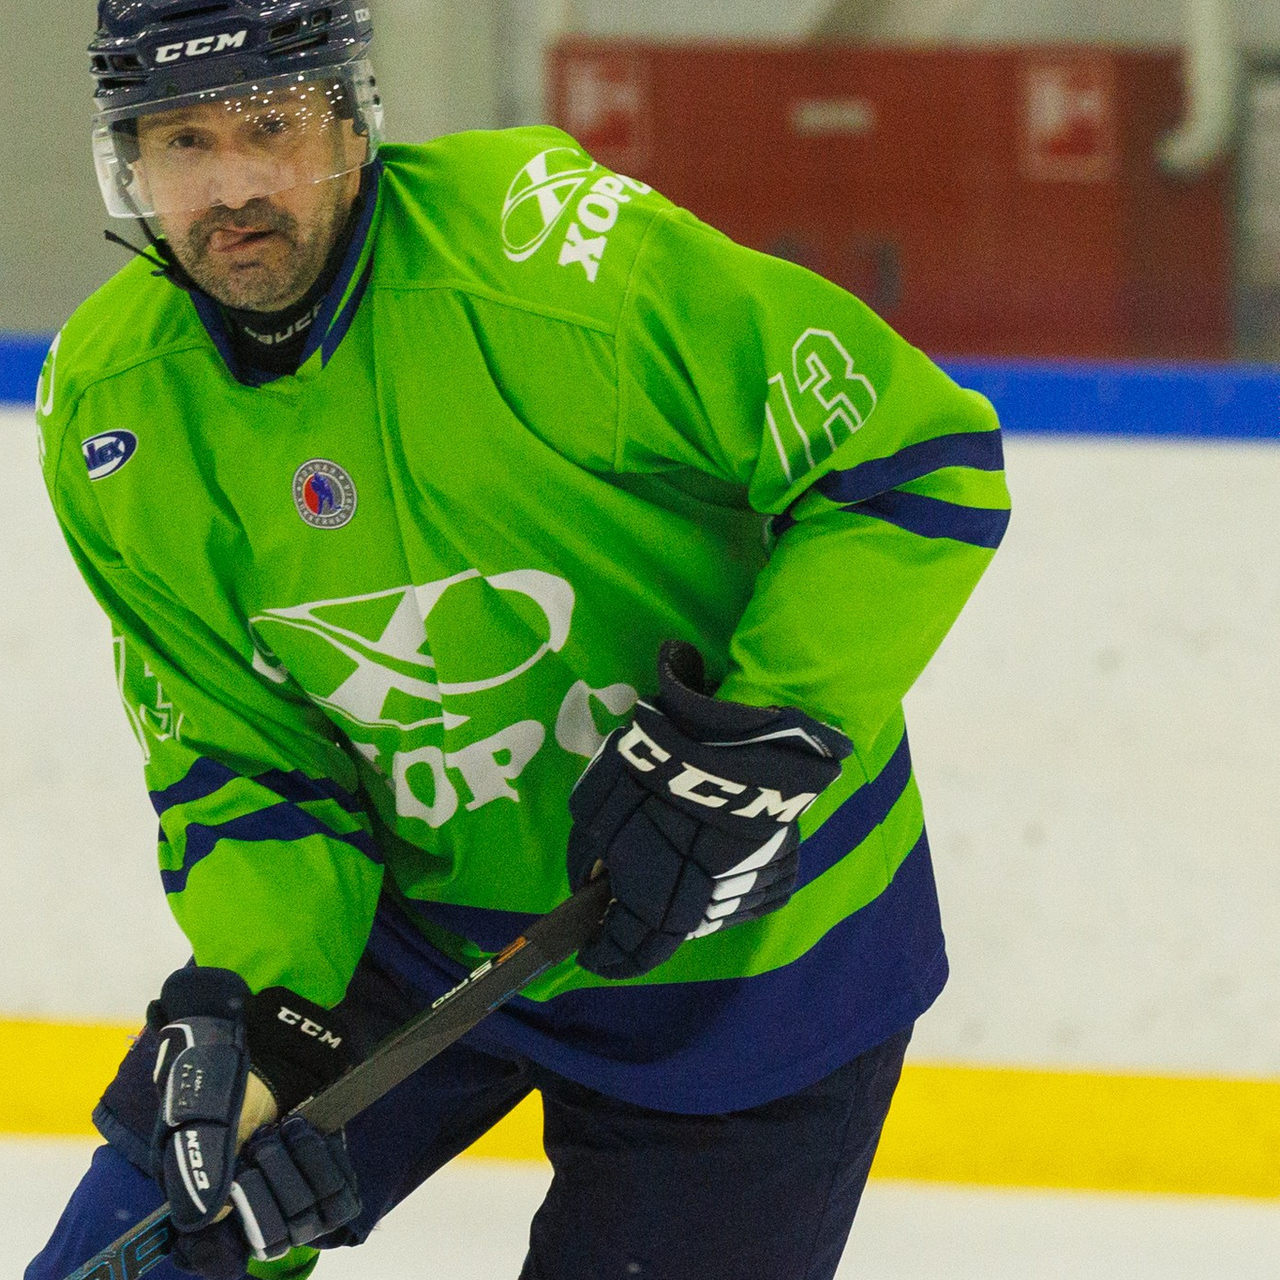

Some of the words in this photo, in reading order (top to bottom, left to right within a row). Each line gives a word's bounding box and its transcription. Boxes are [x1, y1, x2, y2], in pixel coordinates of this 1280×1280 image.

[154, 29, 248, 64] CCM
[765, 326, 878, 487] 13
[618, 719, 819, 824] CCM
[277, 1005, 342, 1049] CCM
[185, 1129, 211, 1191] CCM
